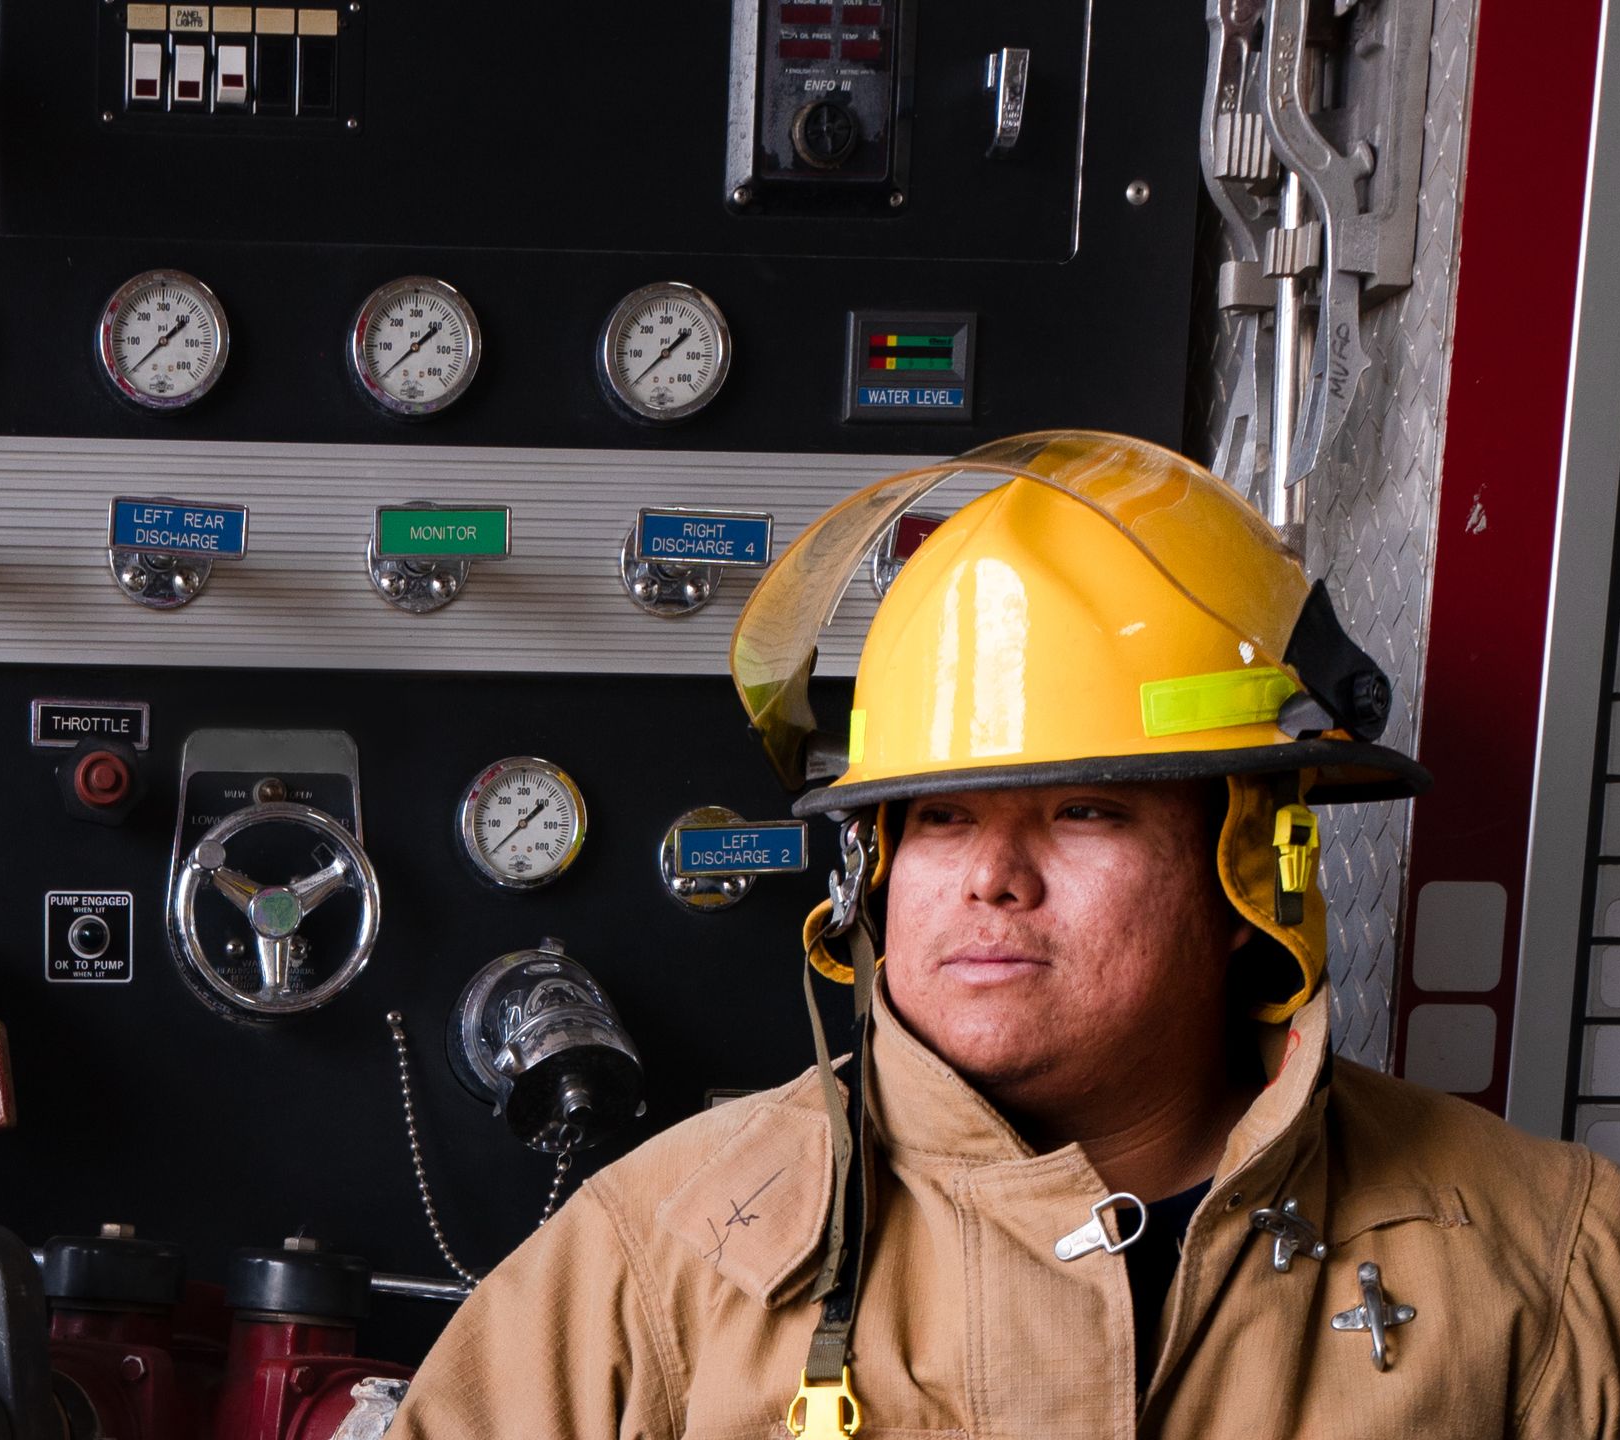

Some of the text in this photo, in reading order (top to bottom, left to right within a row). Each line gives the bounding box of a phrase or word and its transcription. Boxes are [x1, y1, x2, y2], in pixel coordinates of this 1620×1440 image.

[177, 10, 202, 19] PANEL
[175, 18, 203, 28] LIGHTS
[804, 80, 836, 91] ENFO
[157, 303, 170, 311] 300
[137, 313, 150, 321] 200
[410, 309, 423, 317] 300
[390, 319, 403, 327] 200
[659, 316, 673, 324] 300
[158, 324, 168, 332] psi
[640, 326, 653, 334] 200
[127, 337, 140, 345] 100
[185, 339, 199, 347] 500
[660, 337, 670, 345] psi
[437, 346, 450, 354] 500
[686, 352, 700, 360] 500
[177, 362, 191, 370] 600
[428, 368, 441, 376] 600
[677, 374, 691, 382] 600
[868, 390, 953, 404] WATER LEVEL
[133, 508, 225, 529] LEFT REAR
[410, 525, 477, 540] MONITOR
[683, 523, 726, 539] RIGHT
[135, 528, 219, 550] DISCHARGE
[652, 537, 755, 556] DISCHARGE 4
[52, 716, 130, 732] THROTTLE
[518, 808, 528, 816] psi
[722, 835, 759, 849] LEFT
[691, 849, 790, 865] DISCHARGE 2
[50, 896, 129, 906] PUMP ENGAGED
[55, 960, 124, 970] OK TO PUMP
